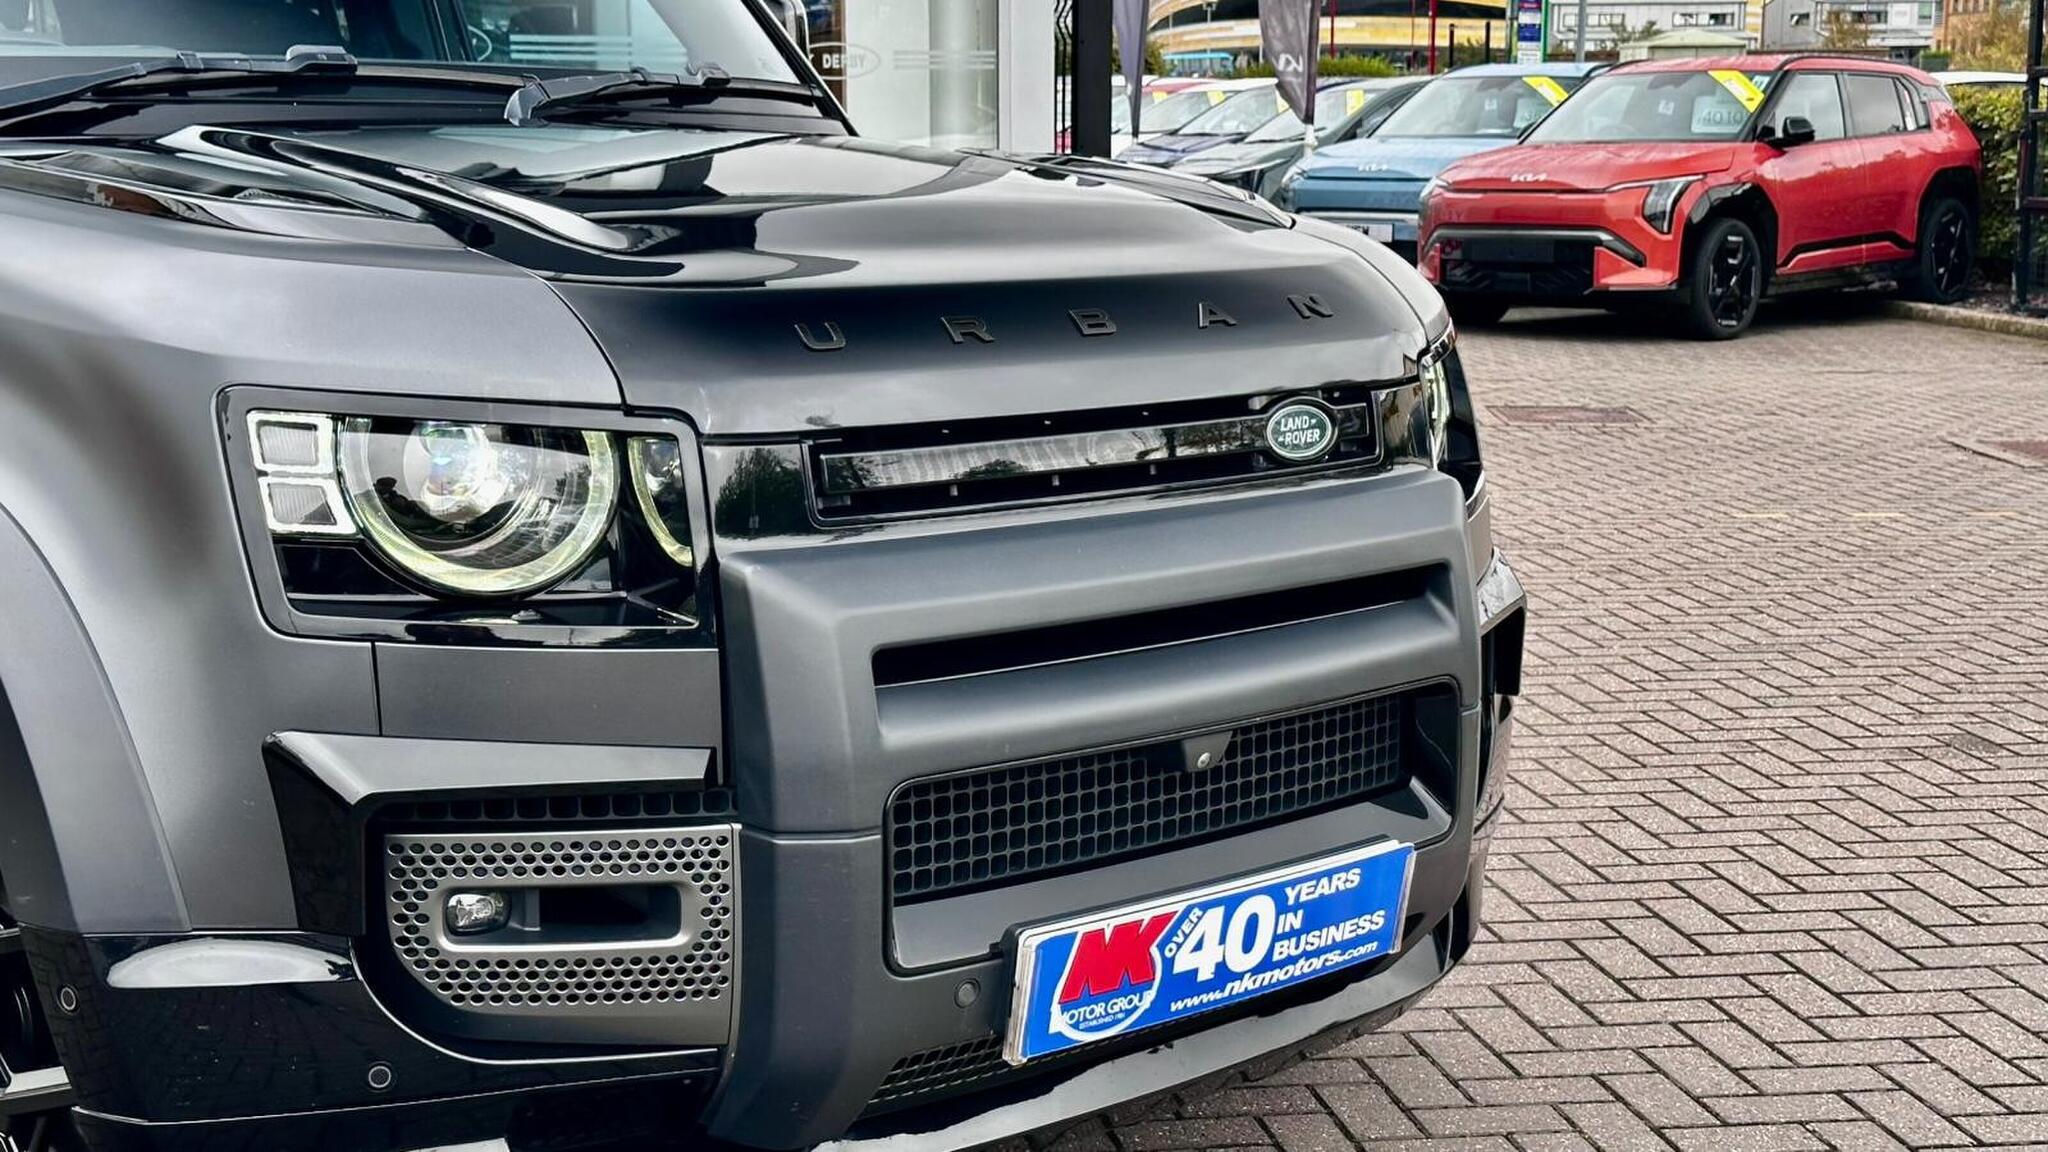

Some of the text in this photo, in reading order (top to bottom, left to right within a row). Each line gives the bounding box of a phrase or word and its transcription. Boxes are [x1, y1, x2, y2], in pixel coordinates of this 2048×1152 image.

[1280, 415, 1310, 432] LAND
[1284, 428, 1321, 445] ROVER
[1284, 867, 1361, 906] YEARS
[1164, 906, 1203, 958] OVER
[1172, 894, 1276, 982] 40
[1272, 909, 1386, 962] BUSINESS
[1276, 909, 1304, 935] IN
[1170, 941, 1379, 1012] www.nkmotors.com
